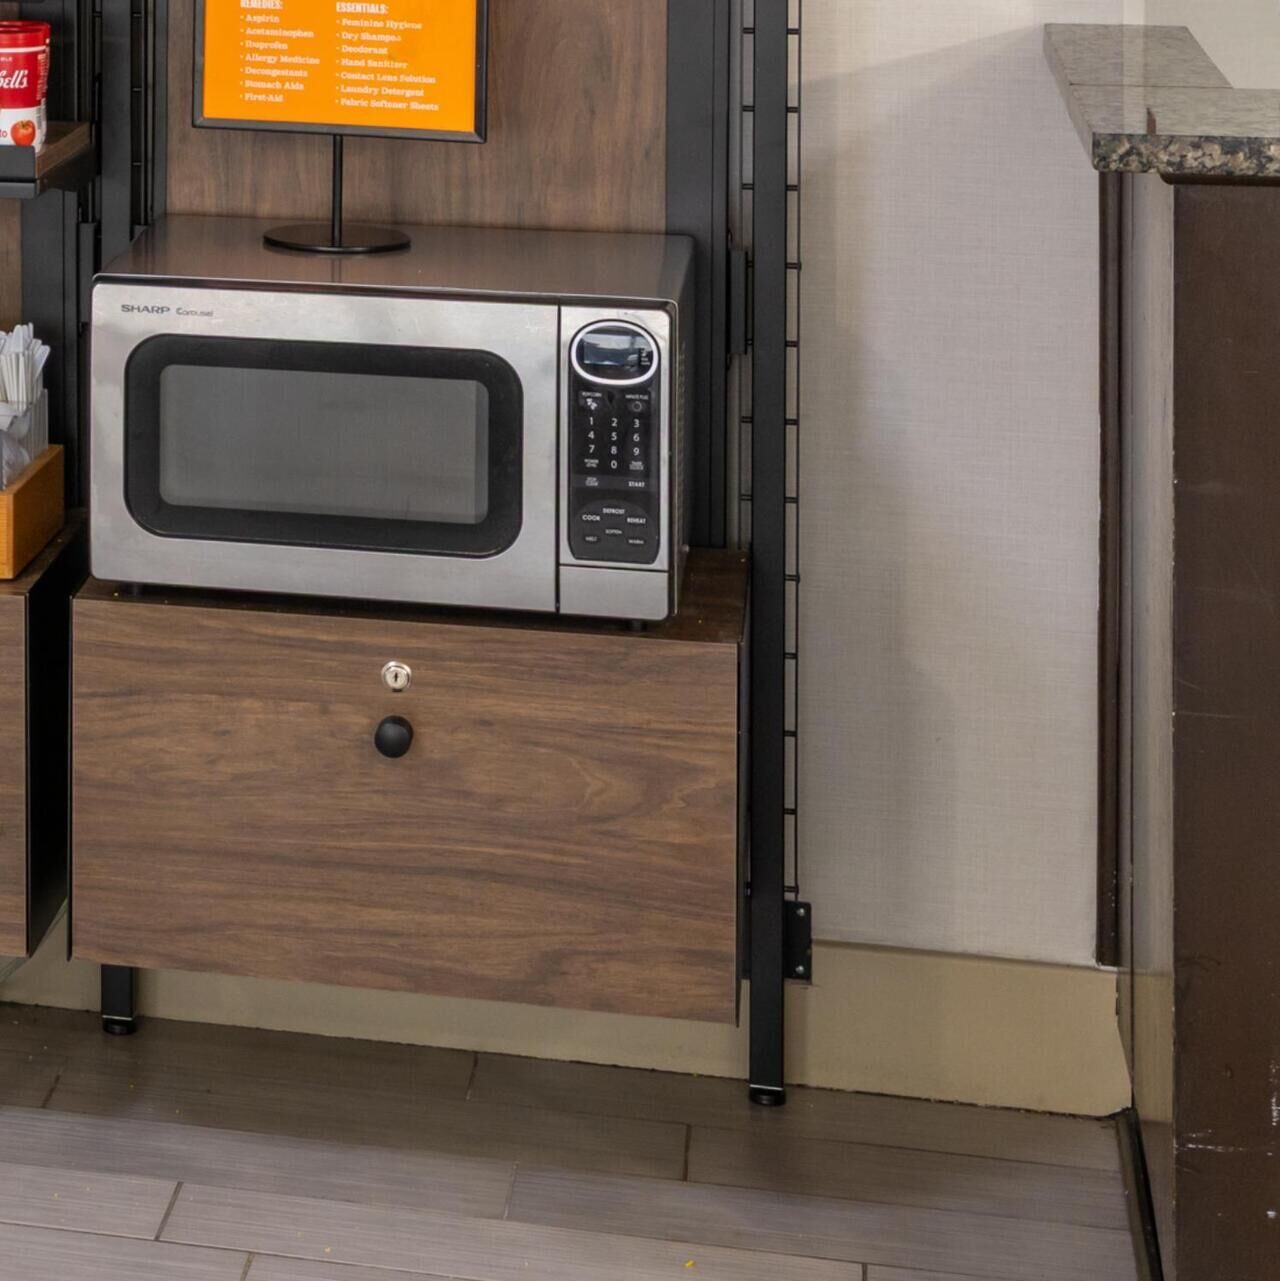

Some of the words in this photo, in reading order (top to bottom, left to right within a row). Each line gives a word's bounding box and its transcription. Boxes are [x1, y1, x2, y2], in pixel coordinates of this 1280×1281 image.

[336, 1, 389, 15] ESSENTIALS:
[121, 304, 170, 314] SHARP
[176, 307, 213, 317] Carousel
